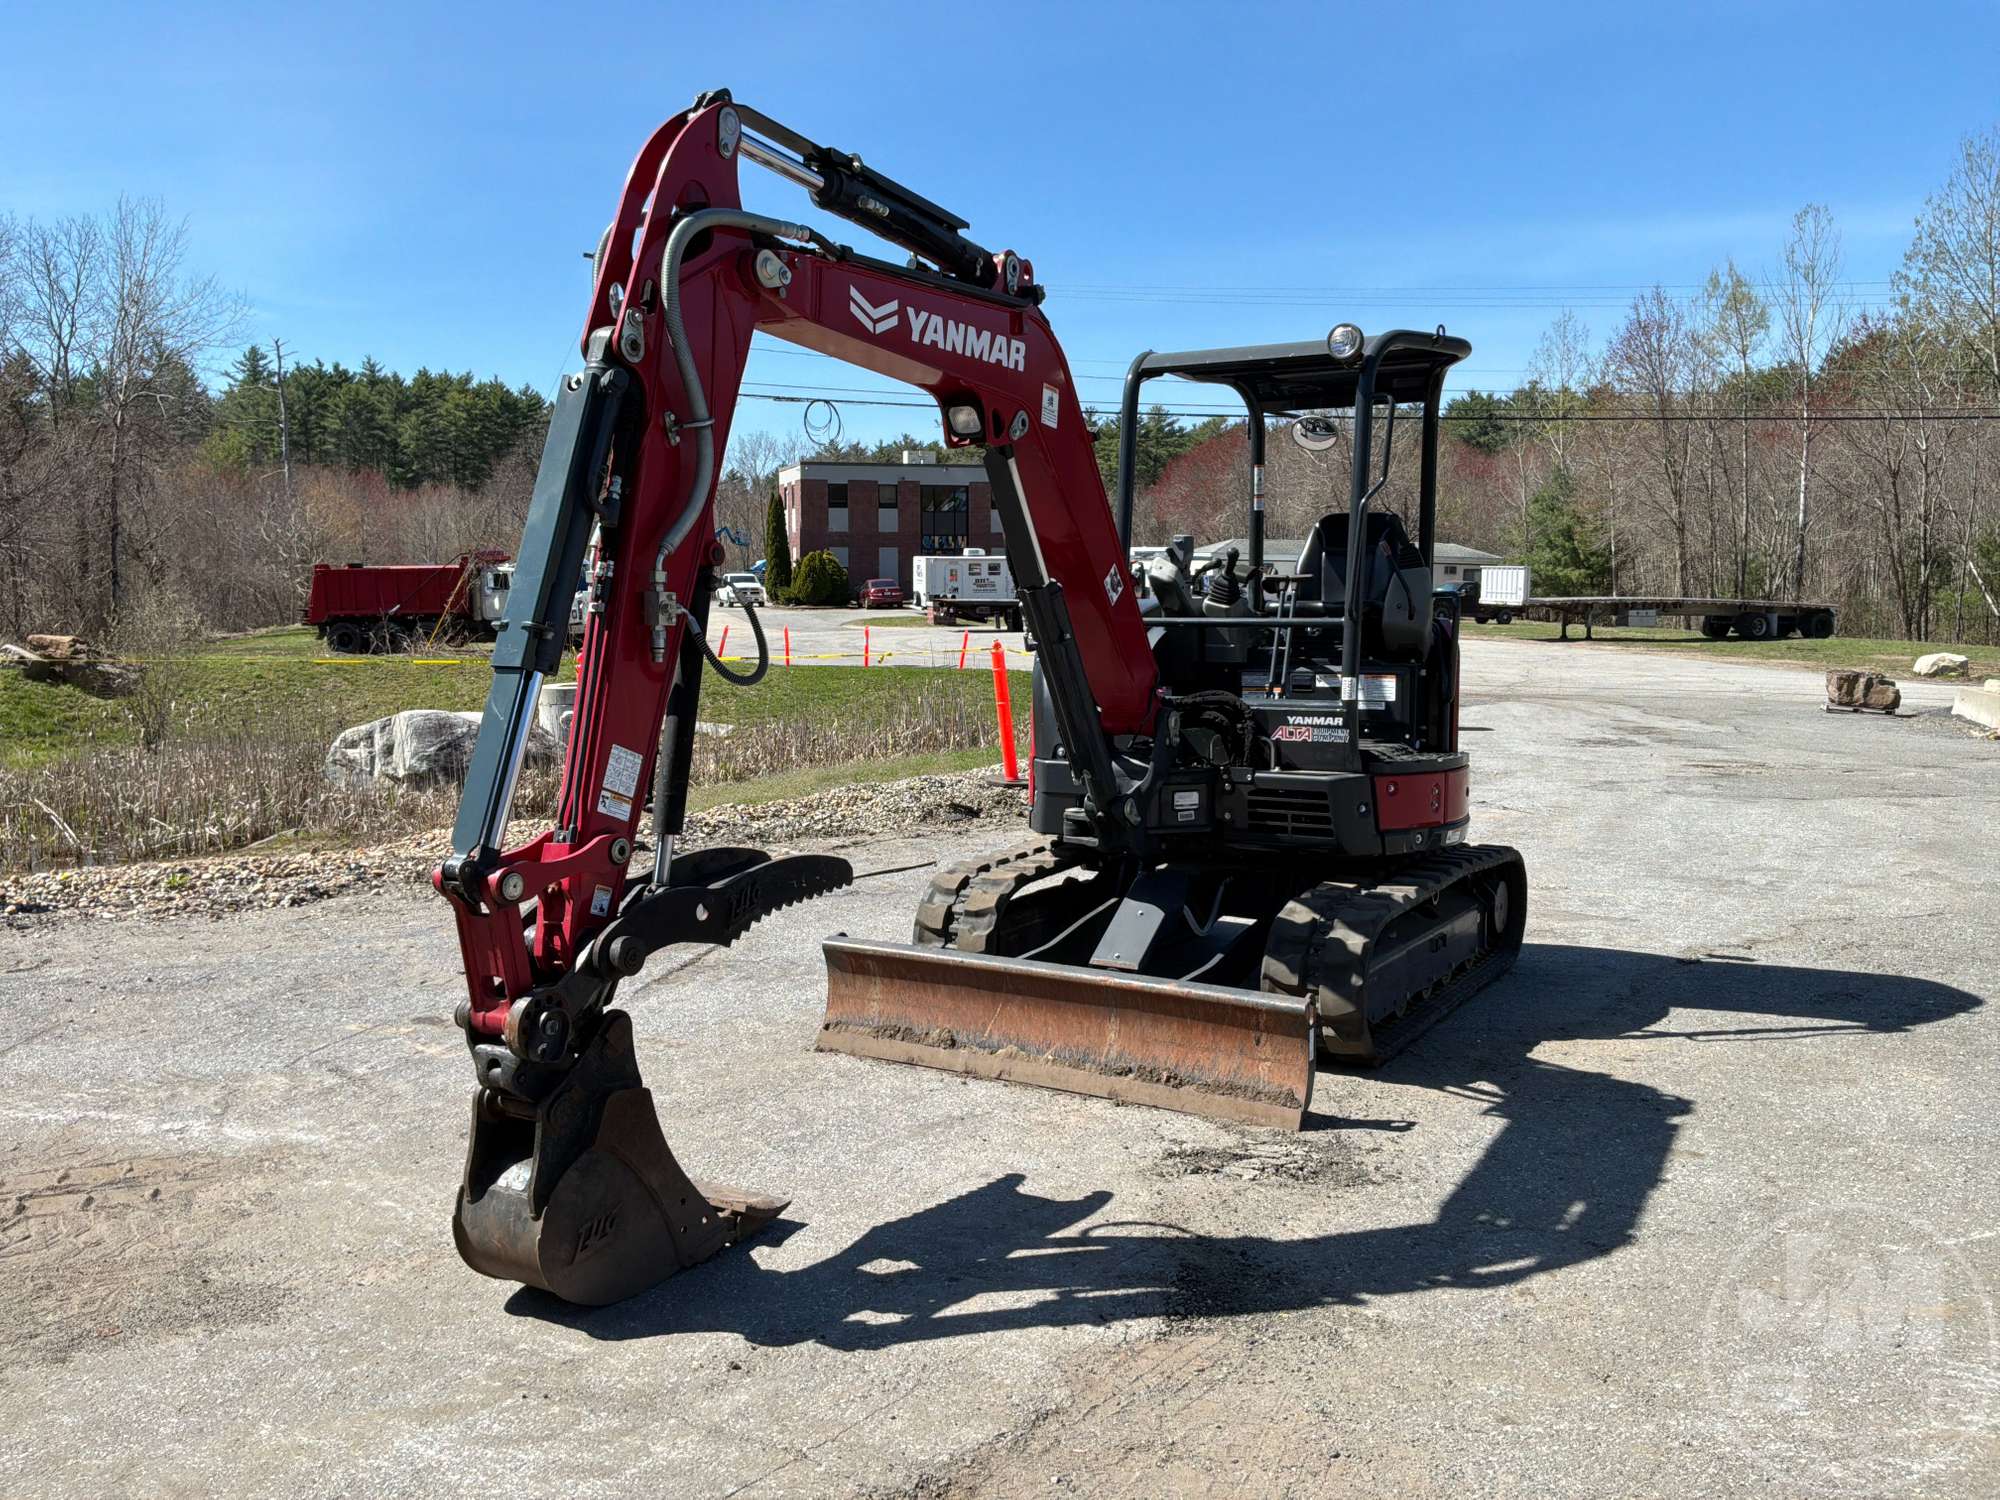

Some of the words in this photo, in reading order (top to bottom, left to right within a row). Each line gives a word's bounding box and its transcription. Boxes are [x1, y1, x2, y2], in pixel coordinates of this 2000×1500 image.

[906, 306, 1026, 372] YANMAR
[1286, 715, 1344, 726] YANMAR
[1271, 725, 1312, 742] ALTA
